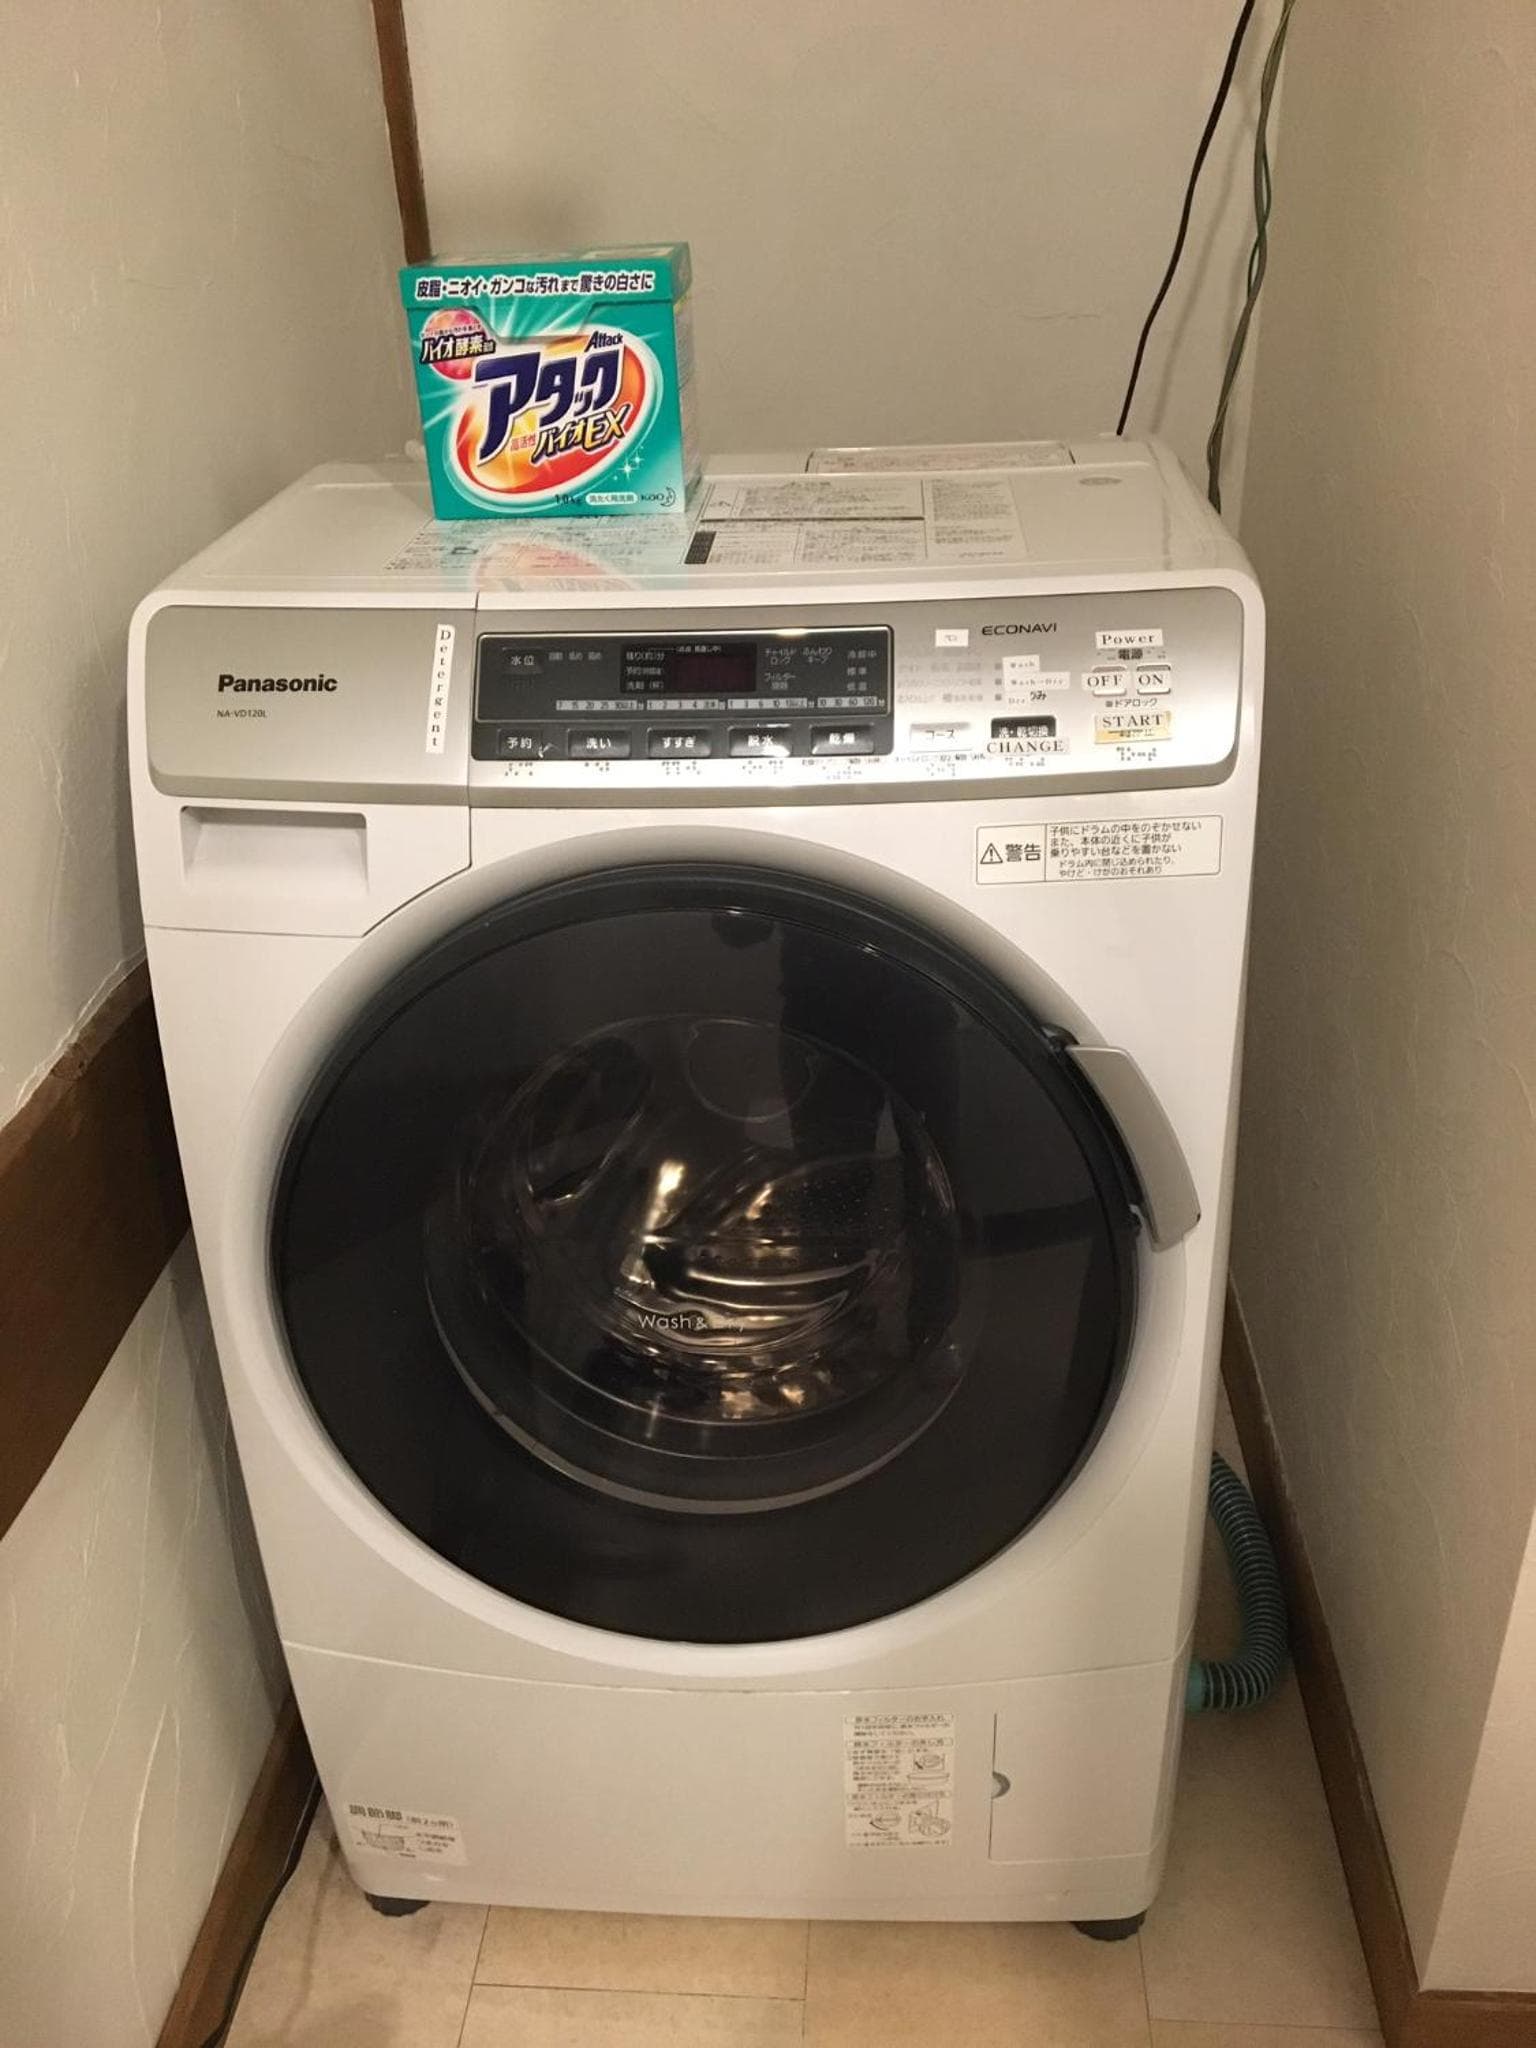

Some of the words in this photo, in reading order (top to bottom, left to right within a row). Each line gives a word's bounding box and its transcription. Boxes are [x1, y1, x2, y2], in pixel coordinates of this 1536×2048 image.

[586, 331, 625, 352] Attack
[474, 349, 622, 461] アタック
[982, 623, 1057, 636] ECONAVI
[1102, 634, 1154, 645] Power
[218, 674, 338, 693] Panasonic
[1087, 674, 1122, 687] OFF
[1138, 674, 1163, 686] ON
[431, 629, 451, 747] Detergent
[1102, 714, 1164, 728] START
[507, 737, 532, 749] 予約
[586, 737, 612, 749] 洗い
[662, 737, 695, 748] すすぎ
[747, 735, 773, 747] 脱水
[987, 740, 1063, 754] CHANGE
[1005, 843, 1041, 862] 警告
[638, 1314, 692, 1329] Wash
[695, 1317, 708, 1330] &
